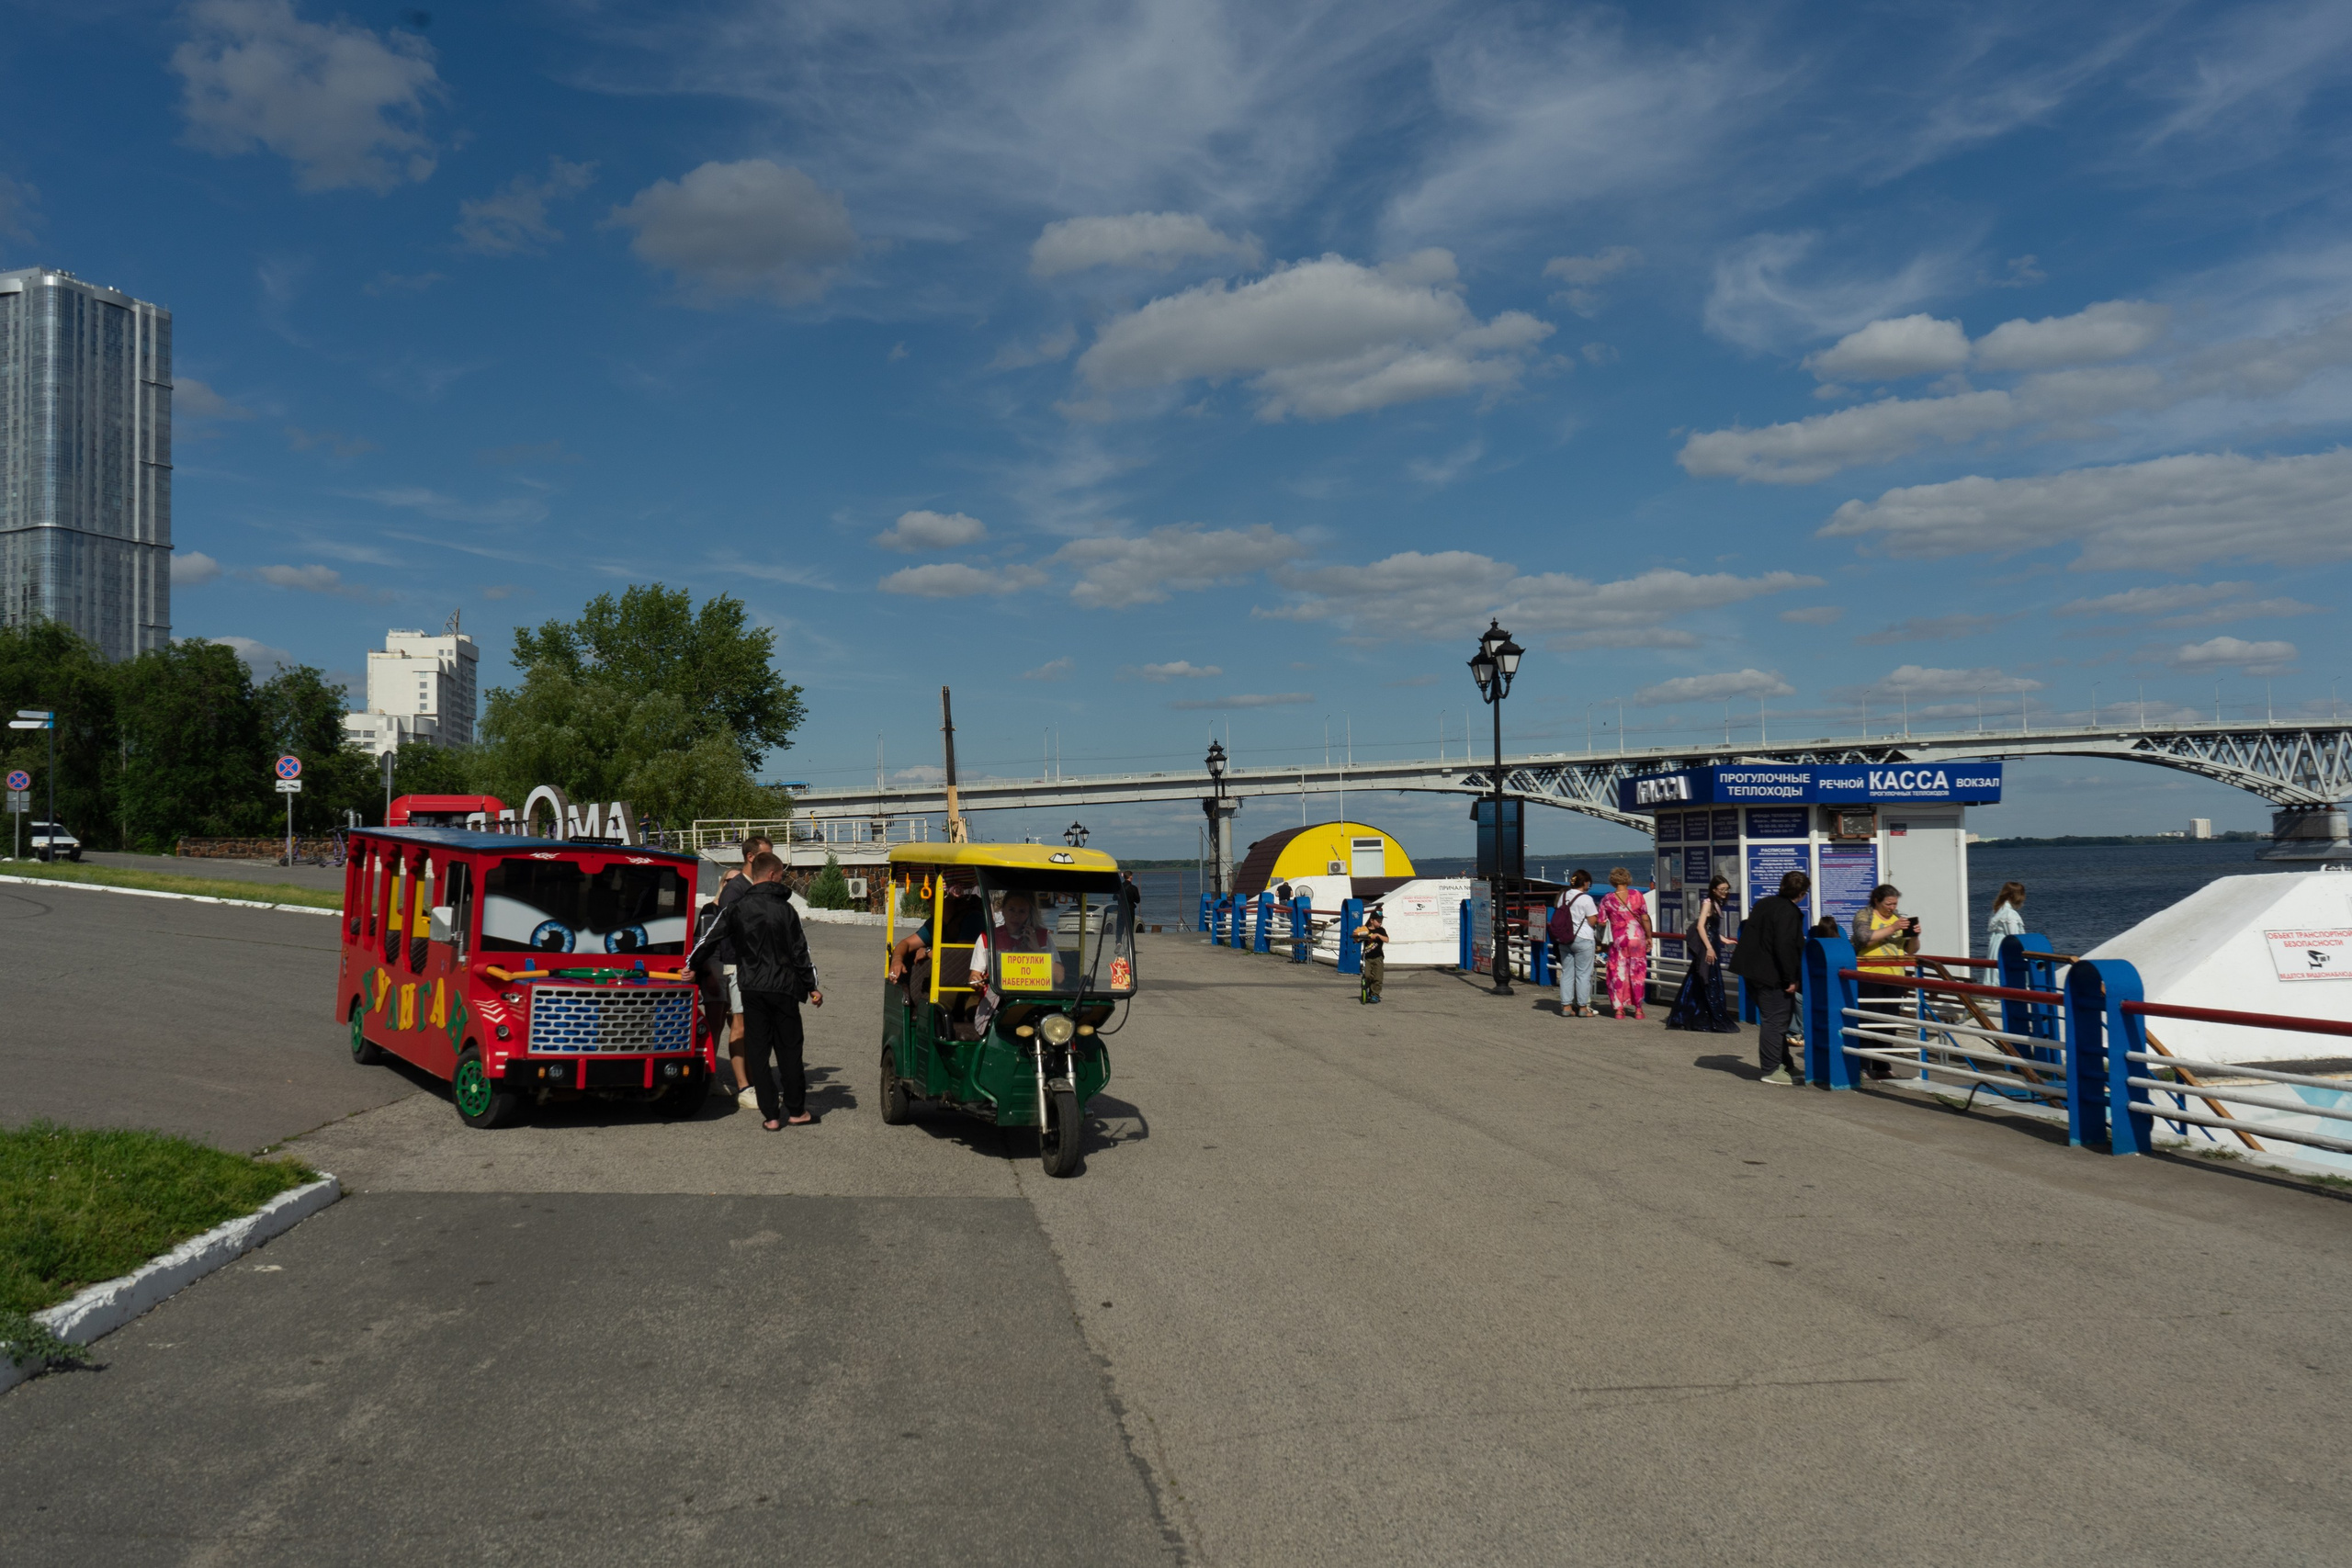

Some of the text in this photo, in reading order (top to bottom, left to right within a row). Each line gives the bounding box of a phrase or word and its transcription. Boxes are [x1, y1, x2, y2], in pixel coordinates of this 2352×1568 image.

[1719, 773, 1811, 784] ПРОГУЛОЧНЫЕ
[1819, 771, 2000, 790] РЕЧНОЙ КАССА ВОКЗАЛ
[1636, 776, 1691, 804] КАССА
[1727, 786, 1803, 797] ТЕПЛОХОДЫ
[2295, 930, 2352, 938] ТРАНСПОРТНОЙ
[2283, 940, 2344, 948] БЕЗОПАСНОСТИ
[1007, 955, 1045, 964] ПРОГУЛКИ
[1020, 967, 1032, 976] ПО
[1001, 976, 1051, 987] НАБЕРЕЖНОЙ
[1112, 975, 1124, 985] 80
